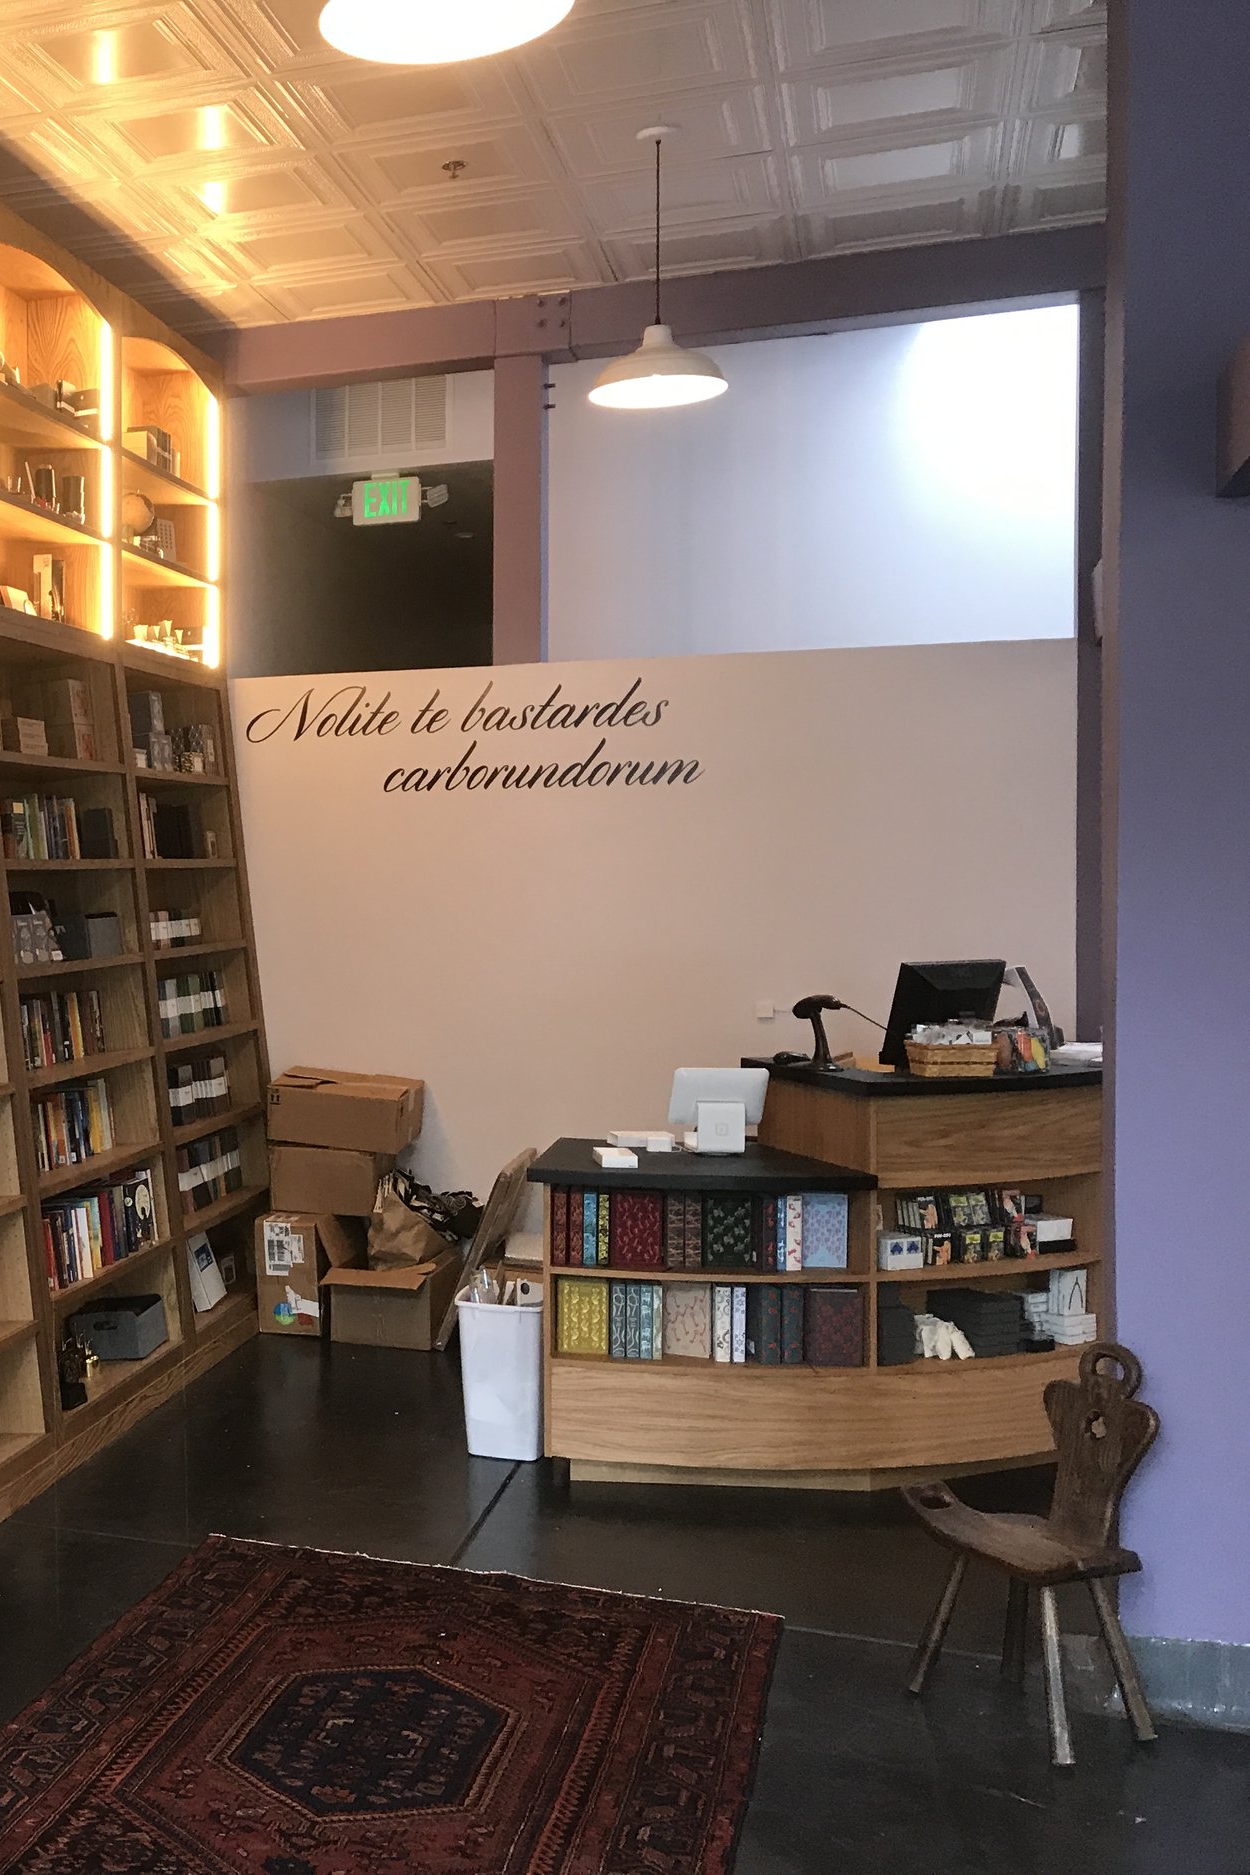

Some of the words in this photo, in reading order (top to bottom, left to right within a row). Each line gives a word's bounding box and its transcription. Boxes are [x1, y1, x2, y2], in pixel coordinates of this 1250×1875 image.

[364, 480, 411, 518] EXIT
[246, 686, 402, 743] Nolite
[410, 689, 452, 734] te
[461, 677, 670, 733] bastardes
[383, 737, 706, 793] carborundorum
